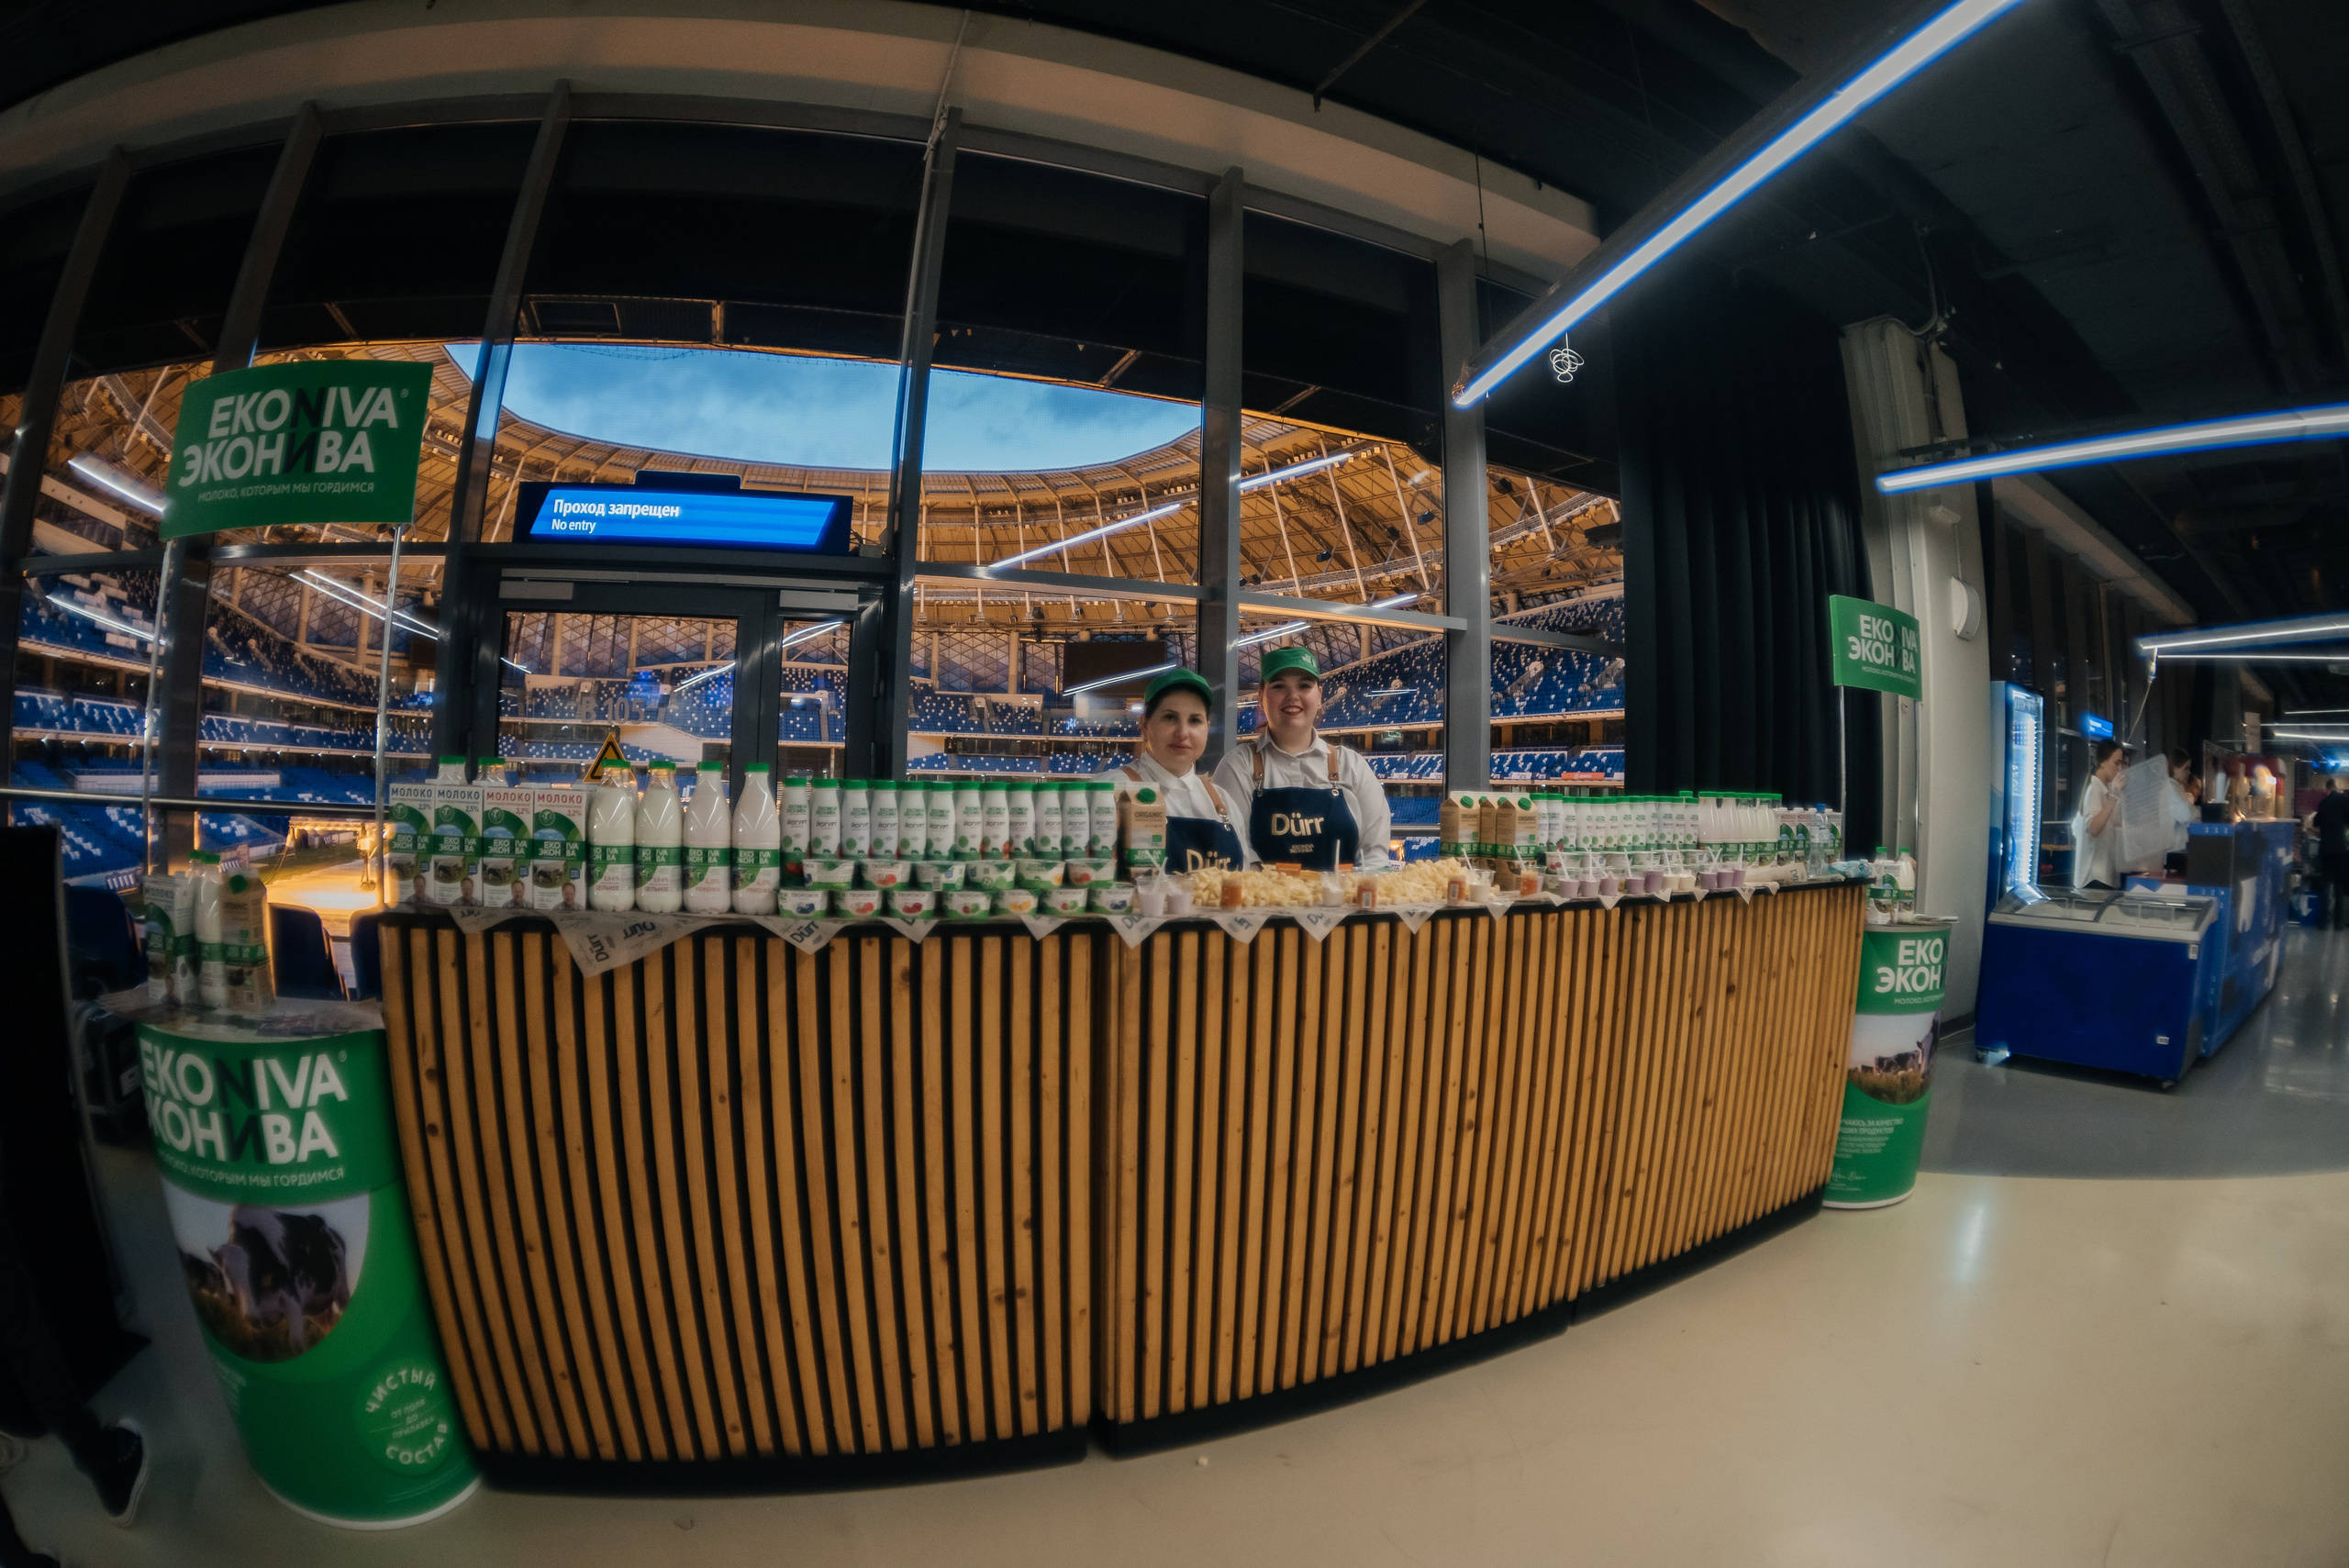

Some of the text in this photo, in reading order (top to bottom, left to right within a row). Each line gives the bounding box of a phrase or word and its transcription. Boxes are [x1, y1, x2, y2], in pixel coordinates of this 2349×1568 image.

[207, 386, 399, 439] EKONIVA
[178, 430, 375, 487] ЭКОНИВА
[197, 482, 374, 503] МОЛОКО, КОТОРЫМ МЫ ГОРДИМСЯ
[553, 499, 680, 518] Проход запрещен
[551, 519, 596, 533] No entry
[1860, 615, 1918, 653] EKONIVA
[1847, 636, 1916, 674] ЭКОНИВА
[604, 696, 645, 725] 105
[391, 788, 432, 797] МОЛОКО
[438, 790, 480, 799] МОЛОКО
[486, 792, 530, 802] МОЛОКО
[537, 794, 583, 804] МОЛОКО
[1271, 812, 1325, 836] Dürr
[393, 841, 426, 850] ЭКОНВА
[397, 835, 429, 843] EKOIVA
[439, 844, 473, 852] ЭКОНВА
[444, 837, 476, 845] EKOIVA
[493, 840, 527, 848] EKOIVA
[543, 841, 579, 850] EKOIVA
[539, 849, 576, 857] ЭКОНВА
[623, 921, 656, 940] Dürr
[790, 920, 819, 944] Dürr
[586, 933, 610, 962] Dürr
[1898, 938, 1947, 966] EKO
[1875, 963, 1945, 994] ЭКОН
[139, 1038, 348, 1110] EKONIVA
[146, 1095, 340, 1164] КОНИВА
[189, 1166, 344, 1187] КОТОРЫМ МЫ ГОРДИМСЯ
[365, 1369, 436, 1413] ЧИСТЫЙ
[390, 1398, 425, 1418] ОТ ПОЛЯ
[406, 1414, 418, 1426] ДО
[386, 1423, 448, 1464] СОСТАВ
